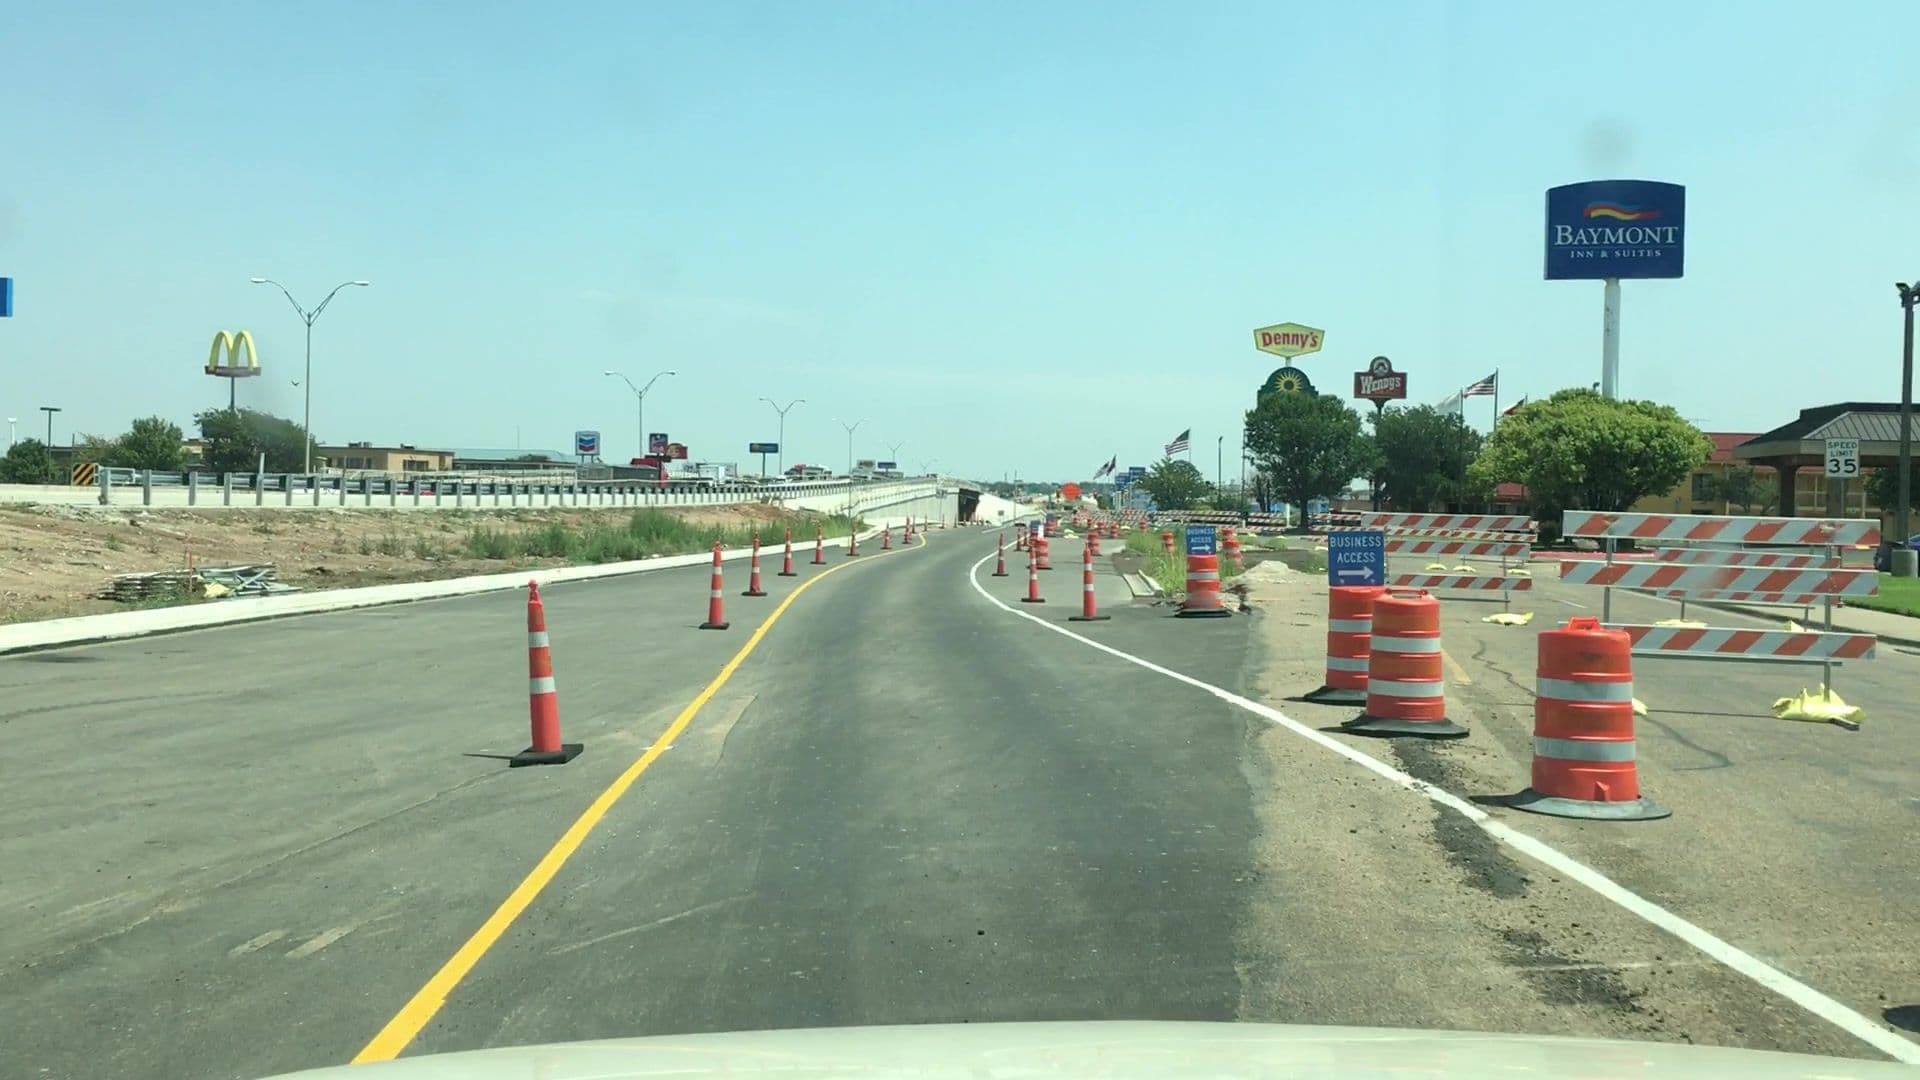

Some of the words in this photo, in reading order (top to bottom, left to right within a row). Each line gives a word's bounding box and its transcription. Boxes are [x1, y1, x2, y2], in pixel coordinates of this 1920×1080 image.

[1554, 225, 1679, 245] BAYMONT
[1570, 250, 1594, 258] INN
[1600, 250, 1609, 258] &
[1614, 249, 1662, 258] SUITES
[1262, 331, 1318, 348] Denny's
[1828, 441, 1857, 449] SPEED
[1828, 458, 1857, 474] 35
[1330, 536, 1382, 548] BUSINESS
[1336, 551, 1376, 564] ACCESS
